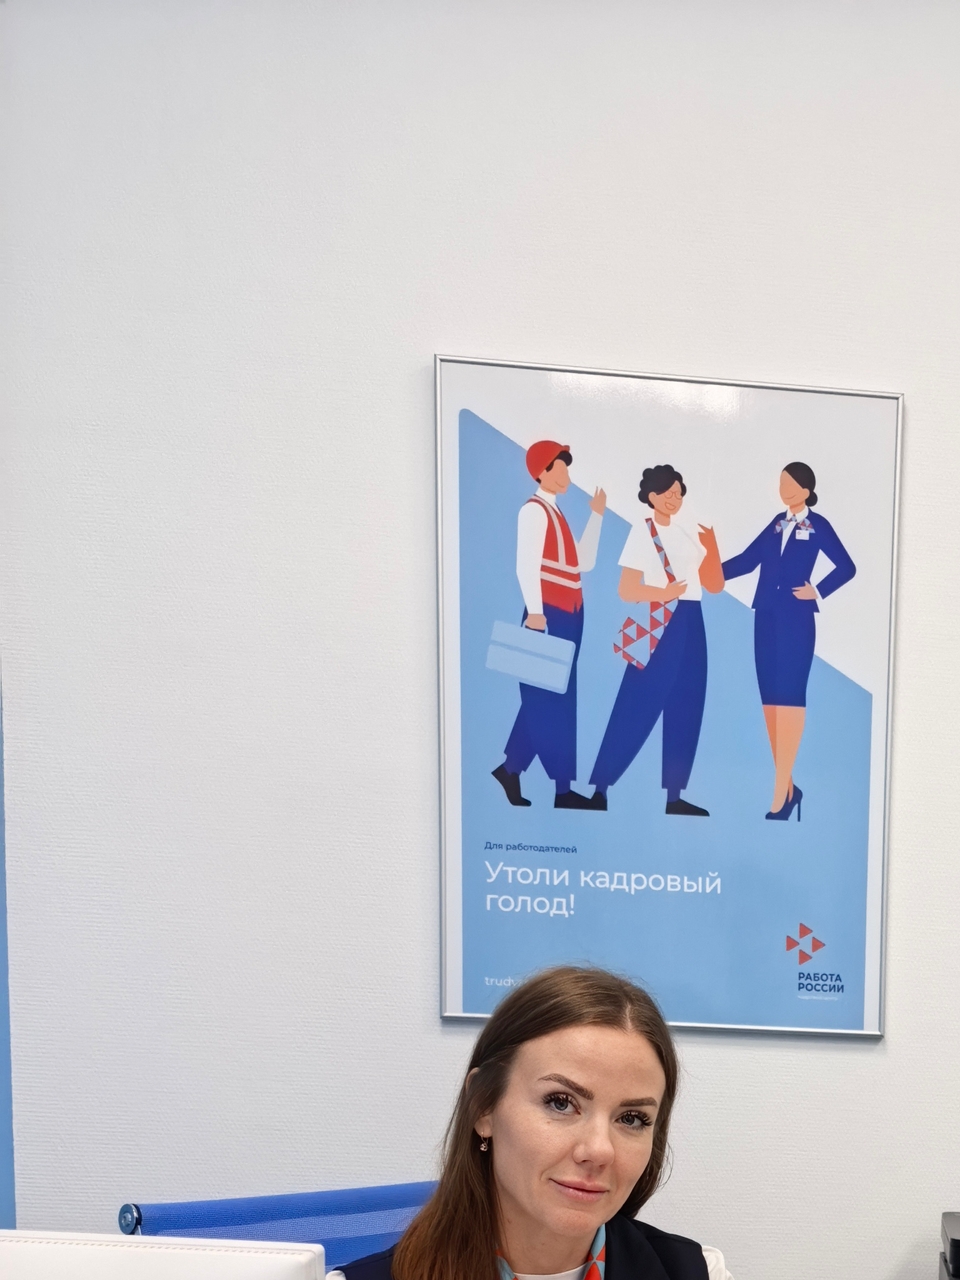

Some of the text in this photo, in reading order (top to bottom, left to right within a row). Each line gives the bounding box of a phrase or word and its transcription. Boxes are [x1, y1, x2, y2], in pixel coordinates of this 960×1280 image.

[484, 841, 578, 854] Для работодателей
[484, 860, 722, 895] Утоли кадровый
[486, 893, 575, 918] голод!
[798, 972, 842, 983] РАБОТА
[797, 982, 845, 993] РОССИИ
